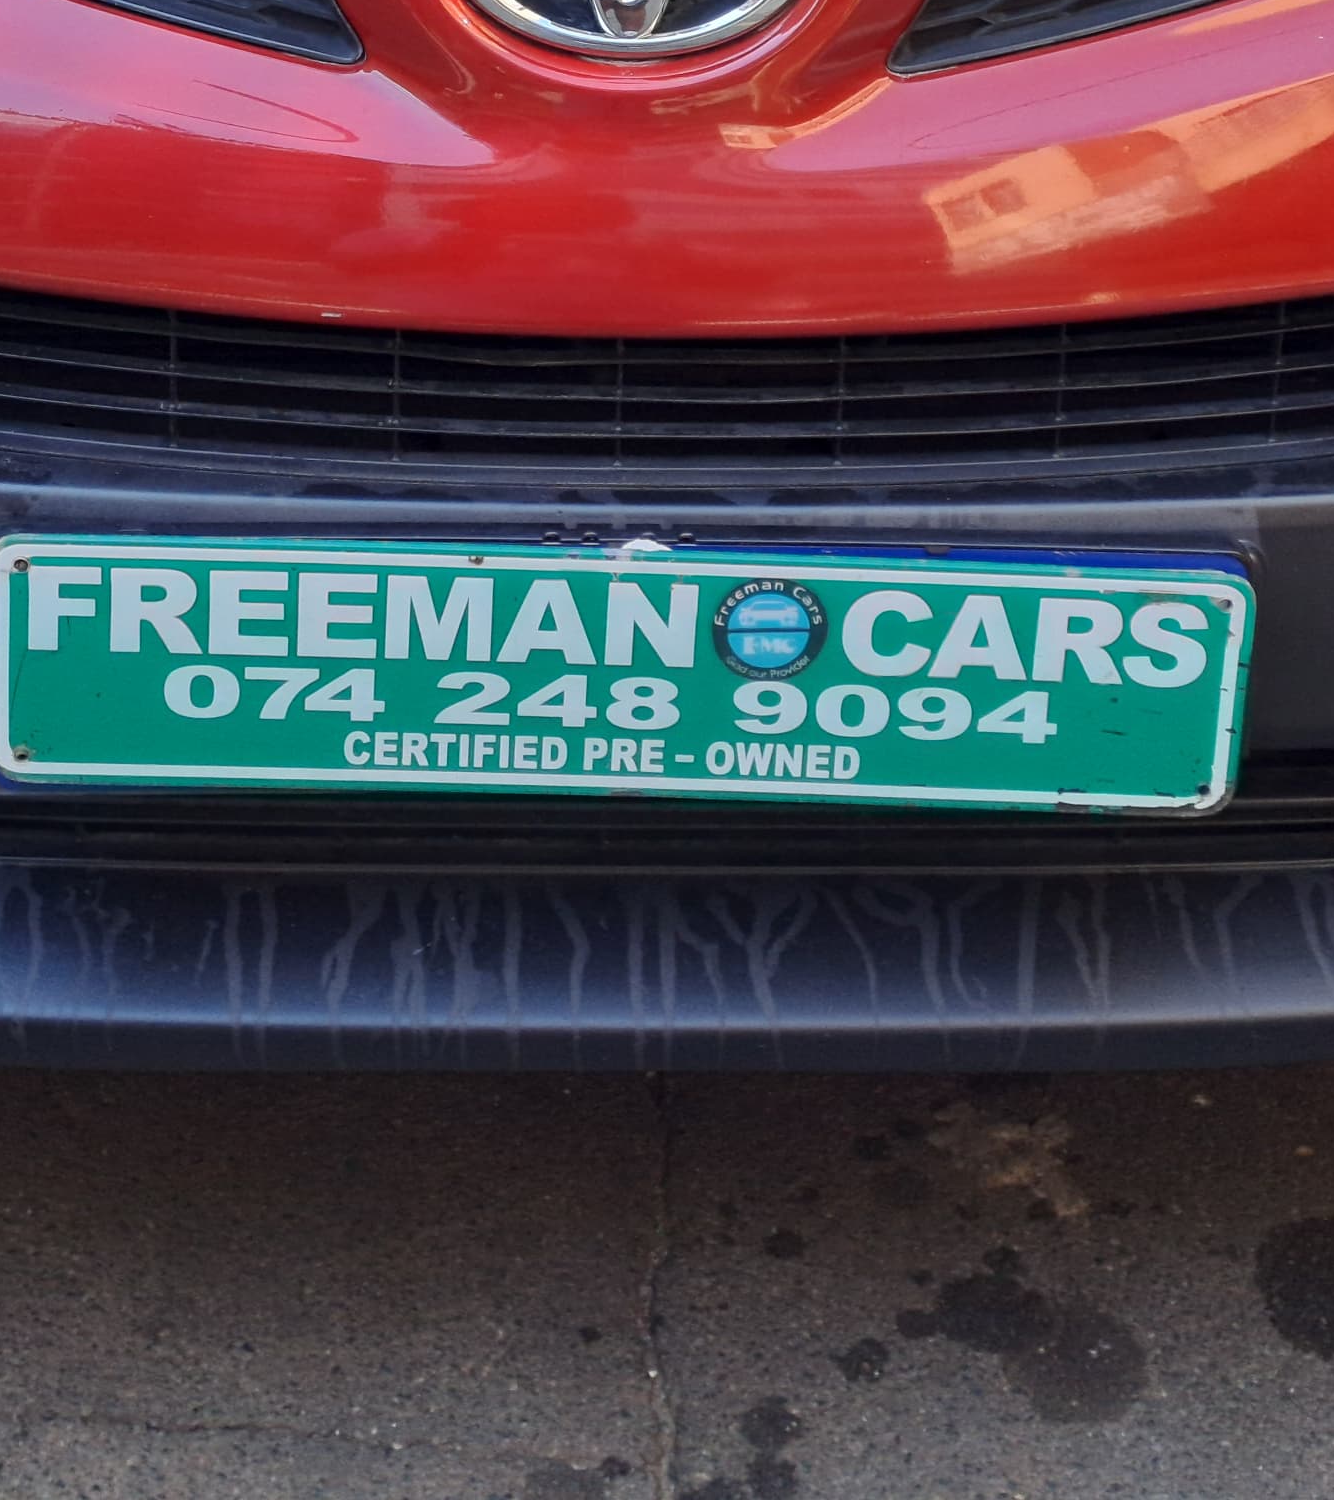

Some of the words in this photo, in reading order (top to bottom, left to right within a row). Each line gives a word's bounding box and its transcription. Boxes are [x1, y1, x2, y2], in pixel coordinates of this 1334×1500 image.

[28, 565, 699, 668] FREEMAN
[841, 588, 1210, 689] CARS
[714, 581, 785, 627] Freeman
[793, 586, 824, 626] Cars
[770, 654, 812, 678] Provider
[163, 664, 386, 722] 074
[434, 671, 681, 731] 248
[733, 680, 1058, 745] 9094
[344, 730, 569, 771] CERTIFIED
[583, 737, 666, 773] PRE
[705, 740, 861, 780] OWNED
